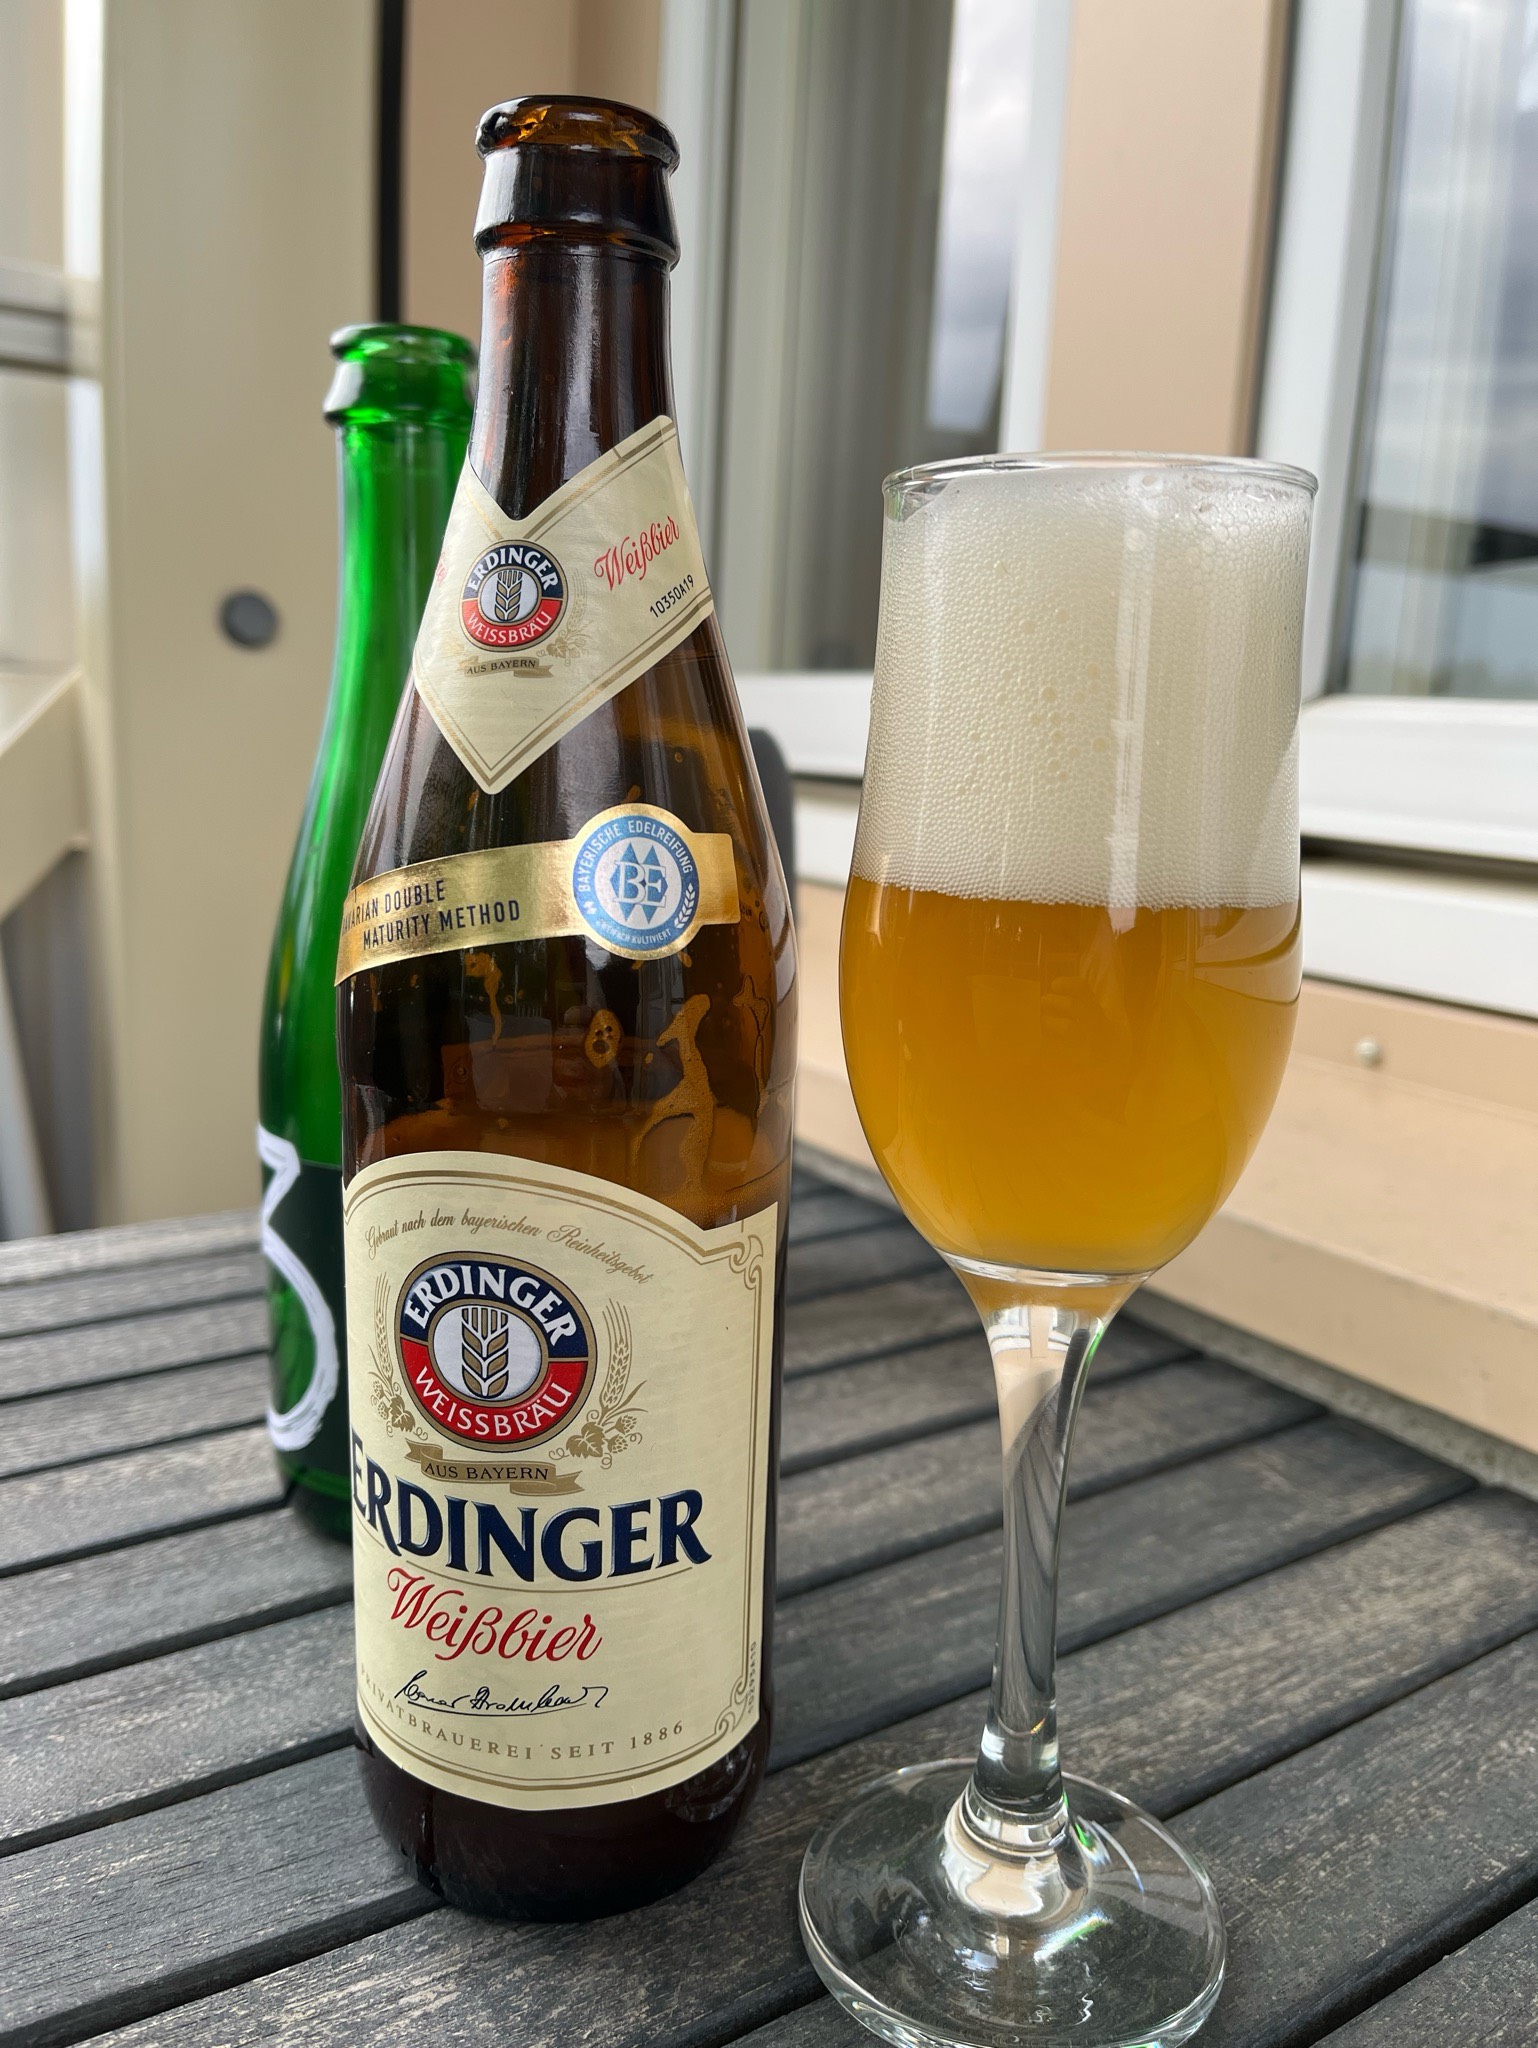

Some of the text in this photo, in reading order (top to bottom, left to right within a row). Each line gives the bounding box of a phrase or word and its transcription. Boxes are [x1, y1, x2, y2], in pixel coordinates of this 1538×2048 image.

[467, 547, 559, 591] ERDINGER
[594, 515, 680, 591] Weißbier
[649, 574, 694, 618] 10350A19
[468, 611, 553, 644] WEISSBRÄU
[467, 659, 536, 675] AUS BAYERN
[577, 820, 694, 892] BAYERISCHE EDELREIFUNG
[363, 899, 520, 950] MATURITY METHOD
[384, 880, 446, 914] DOUBLE
[631, 928, 672, 944] KULTIVIERT
[365, 1208, 655, 1285] Gebraut nach dem bayerischen Reinheitsgebot
[405, 1264, 578, 1347] ERDINGER
[415, 1366, 573, 1438] WEISSBRÄU
[424, 1462, 549, 1482] AUS BAYERN
[351, 1427, 712, 1583] ERDINGER
[387, 1566, 603, 1662] Weißbier
[361, 1662, 533, 1760] PRIVATBRAUEREI
[550, 1741, 615, 1760] SEIT
[629, 1720, 684, 1749] 1886
